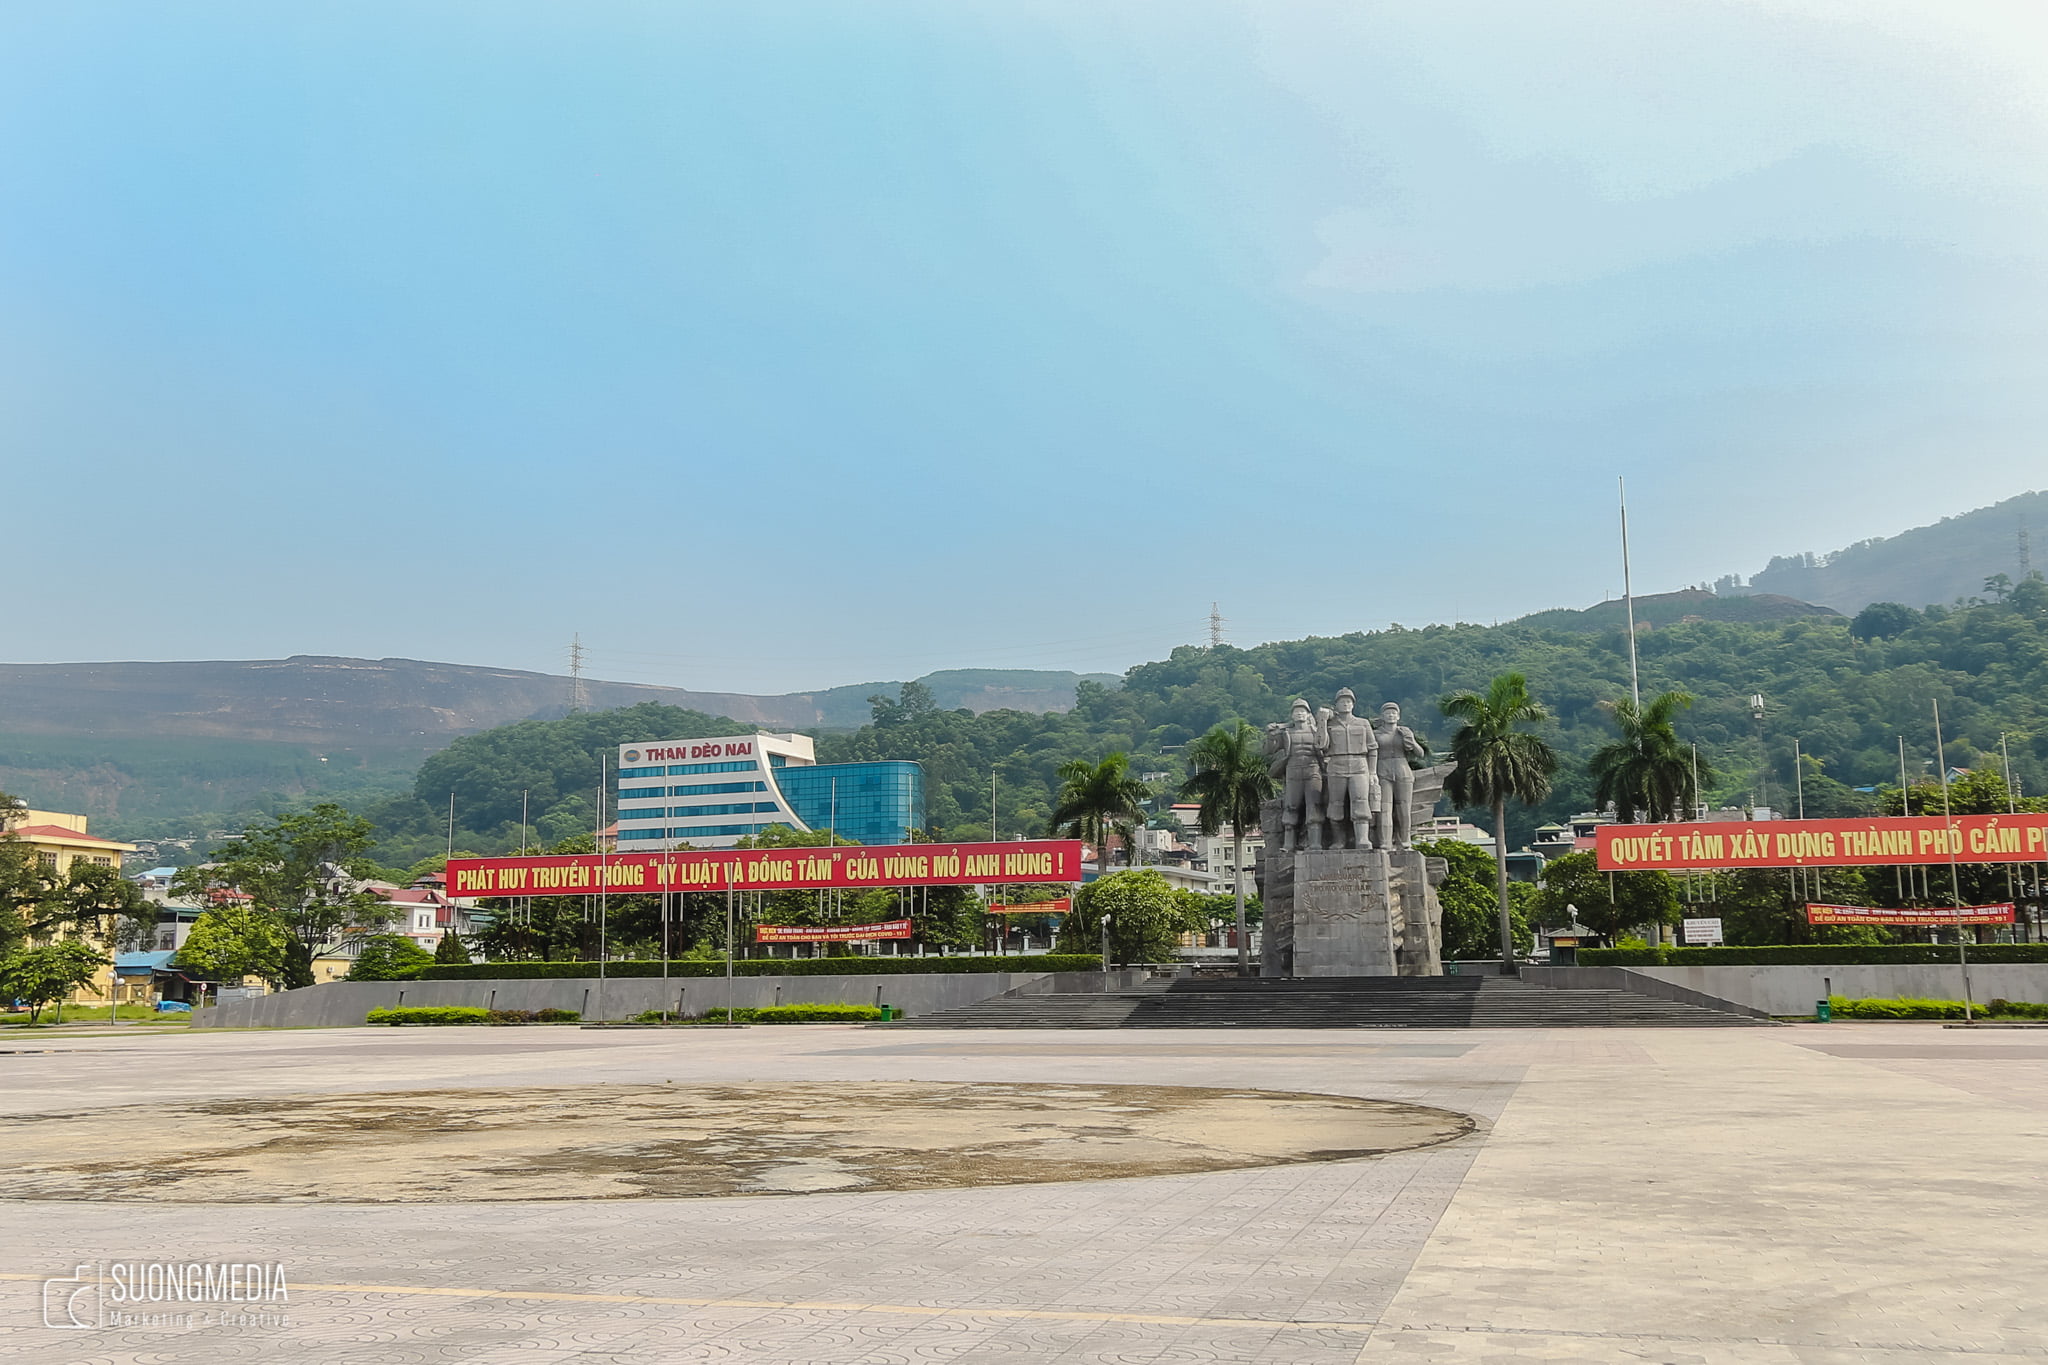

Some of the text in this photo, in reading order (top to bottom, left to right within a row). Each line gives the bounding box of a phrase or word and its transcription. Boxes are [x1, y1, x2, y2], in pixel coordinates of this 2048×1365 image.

[646, 742, 752, 761] THAN ĐÈO NAI
[1611, 817, 2048, 865] QUYẾT TÂM XÂY DỰNG THÀNH PHỐ CẨM P
[457, 865, 495, 891] PHÁT
[498, 867, 528, 890] HUY
[532, 859, 590, 888] TRUYỀN
[593, 857, 644, 887] THỐNG
[682, 858, 720, 888] LUẬT
[748, 853, 793, 883] ĐỒNG
[846, 851, 879, 880] CỦA
[884, 852, 928, 879] VÙNG
[933, 848, 960, 878] MỎ
[965, 854, 1000, 877] ANH
[1005, 849, 1052, 876] HÙNG
[1058, 852, 1064, 875] !
